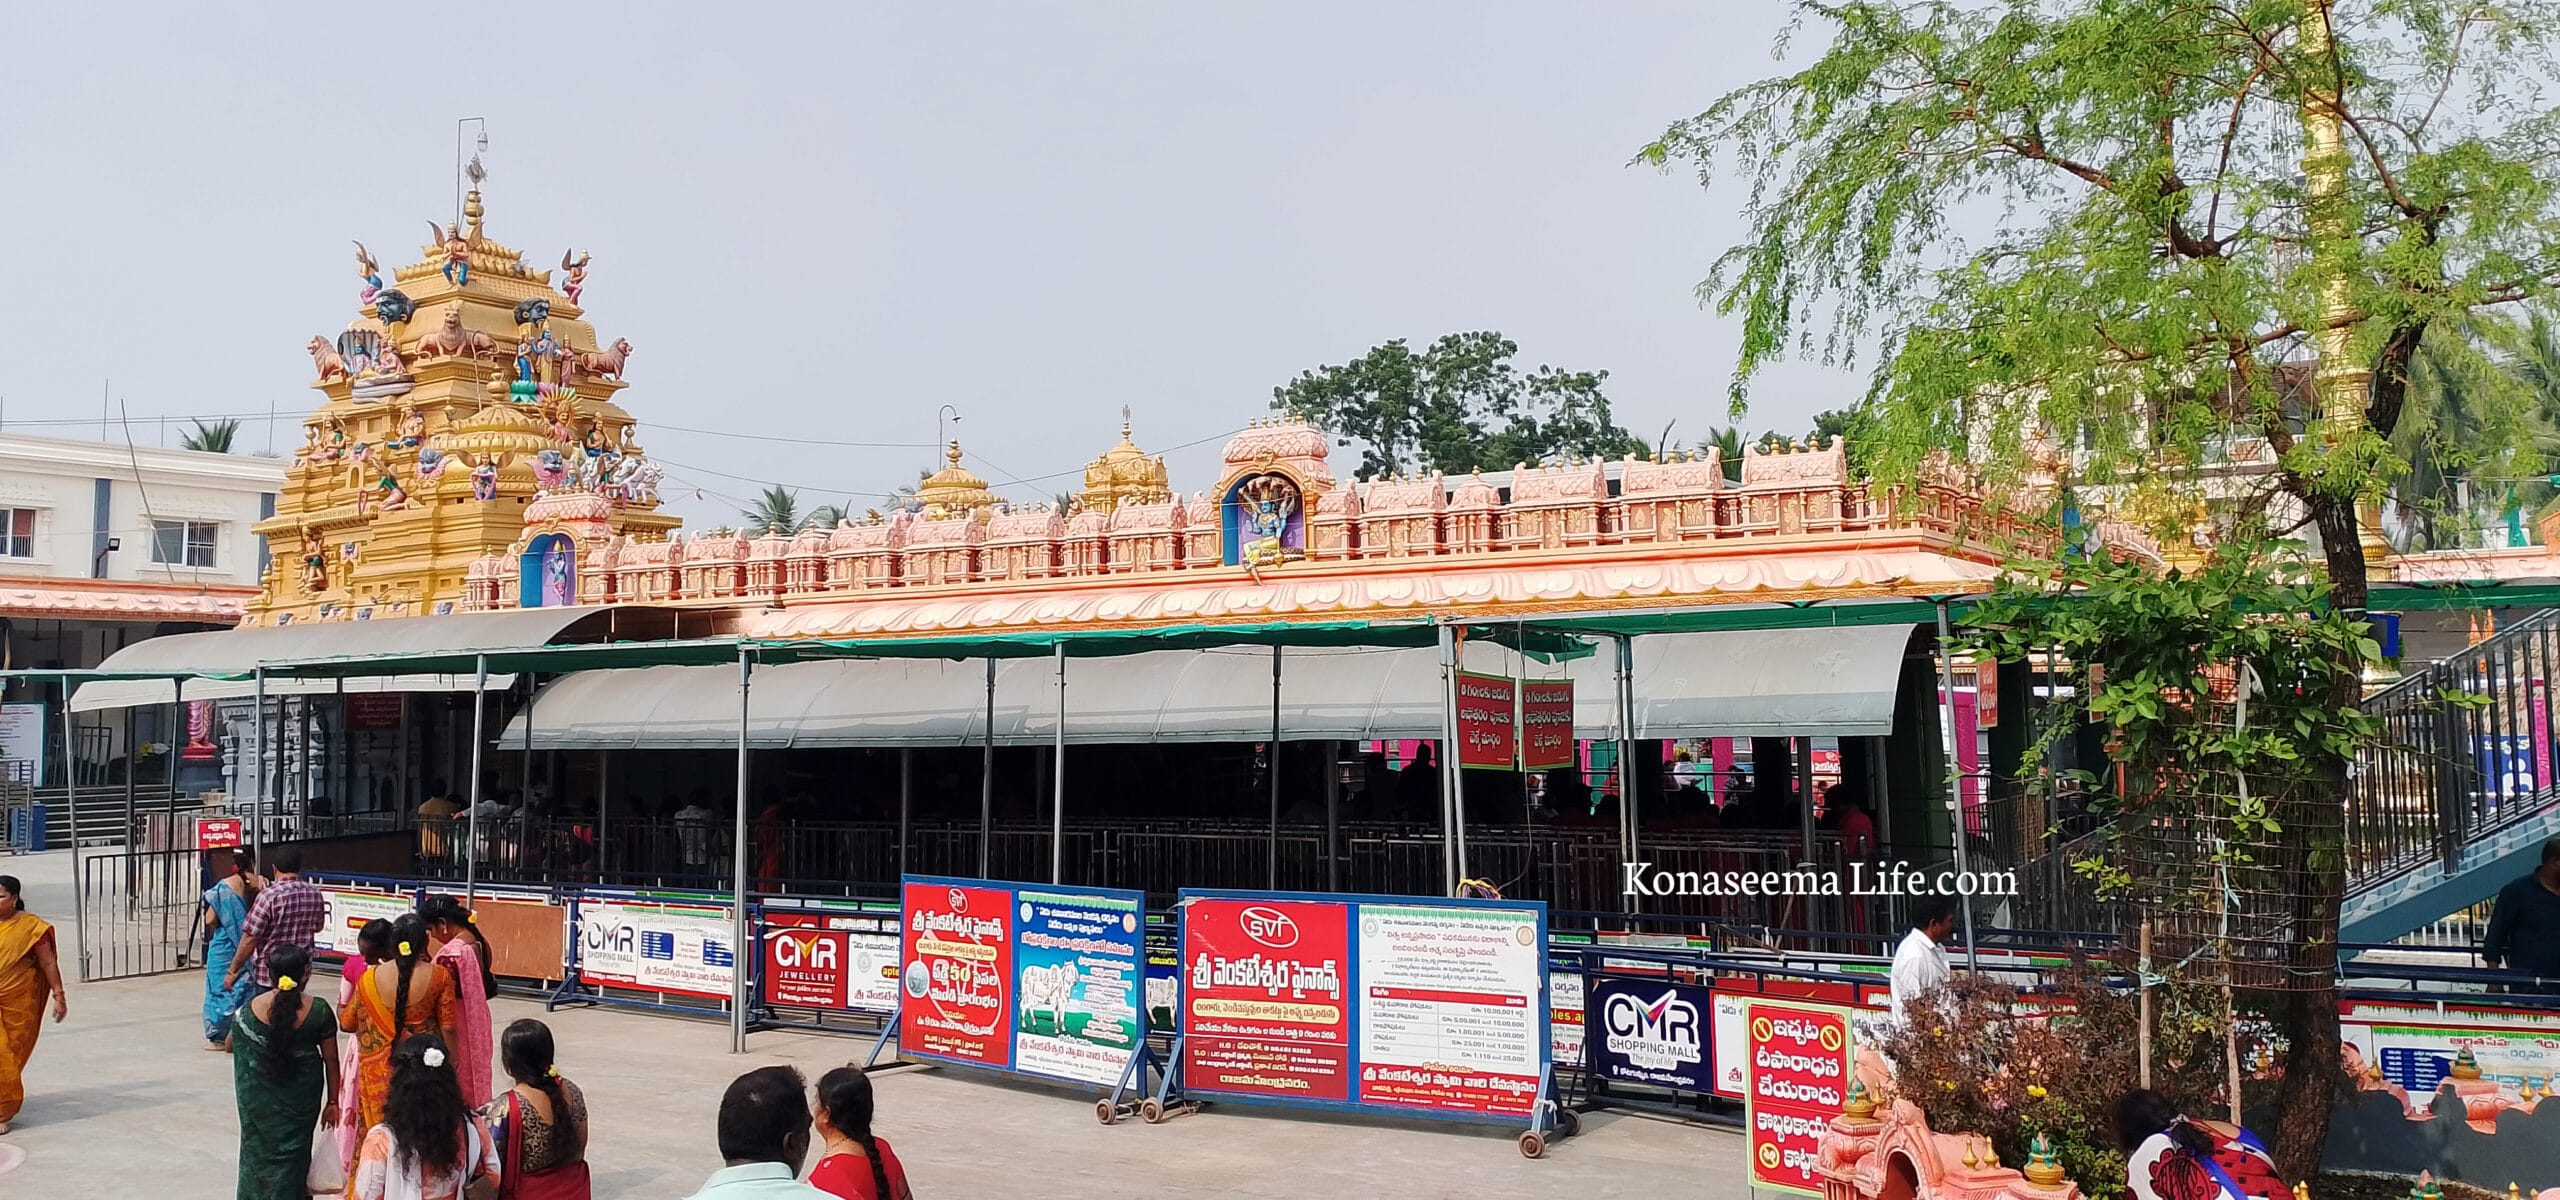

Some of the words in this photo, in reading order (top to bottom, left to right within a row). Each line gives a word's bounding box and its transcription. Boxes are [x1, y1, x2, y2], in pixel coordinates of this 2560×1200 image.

[588, 917, 634, 953] CMR
[587, 951, 615, 961] SHOPPING
[617, 954, 633, 962] MALL
[775, 933, 837, 969] CMR
[779, 971, 836, 982] JEWELLERY
[950, 965, 972, 982] 50
[1193, 953, 1211, 989] శ్రీ
[1608, 989, 1696, 1045] CMR
[1773, 1018, 1819, 1045] ఇచ్చట
[1610, 1039, 1665, 1055] SHOPPING
[1668, 1046, 1697, 1059] MALL
[1632, 1054, 1643, 1064] The
[1644, 1056, 1656, 1066] joy
[1657, 1056, 1664, 1065] of
[1756, 1046, 1839, 1077] దీపారాధన
[1363, 1067, 1376, 1081] శ్రీ
[1758, 1074, 1840, 1105] చేయరాదు
